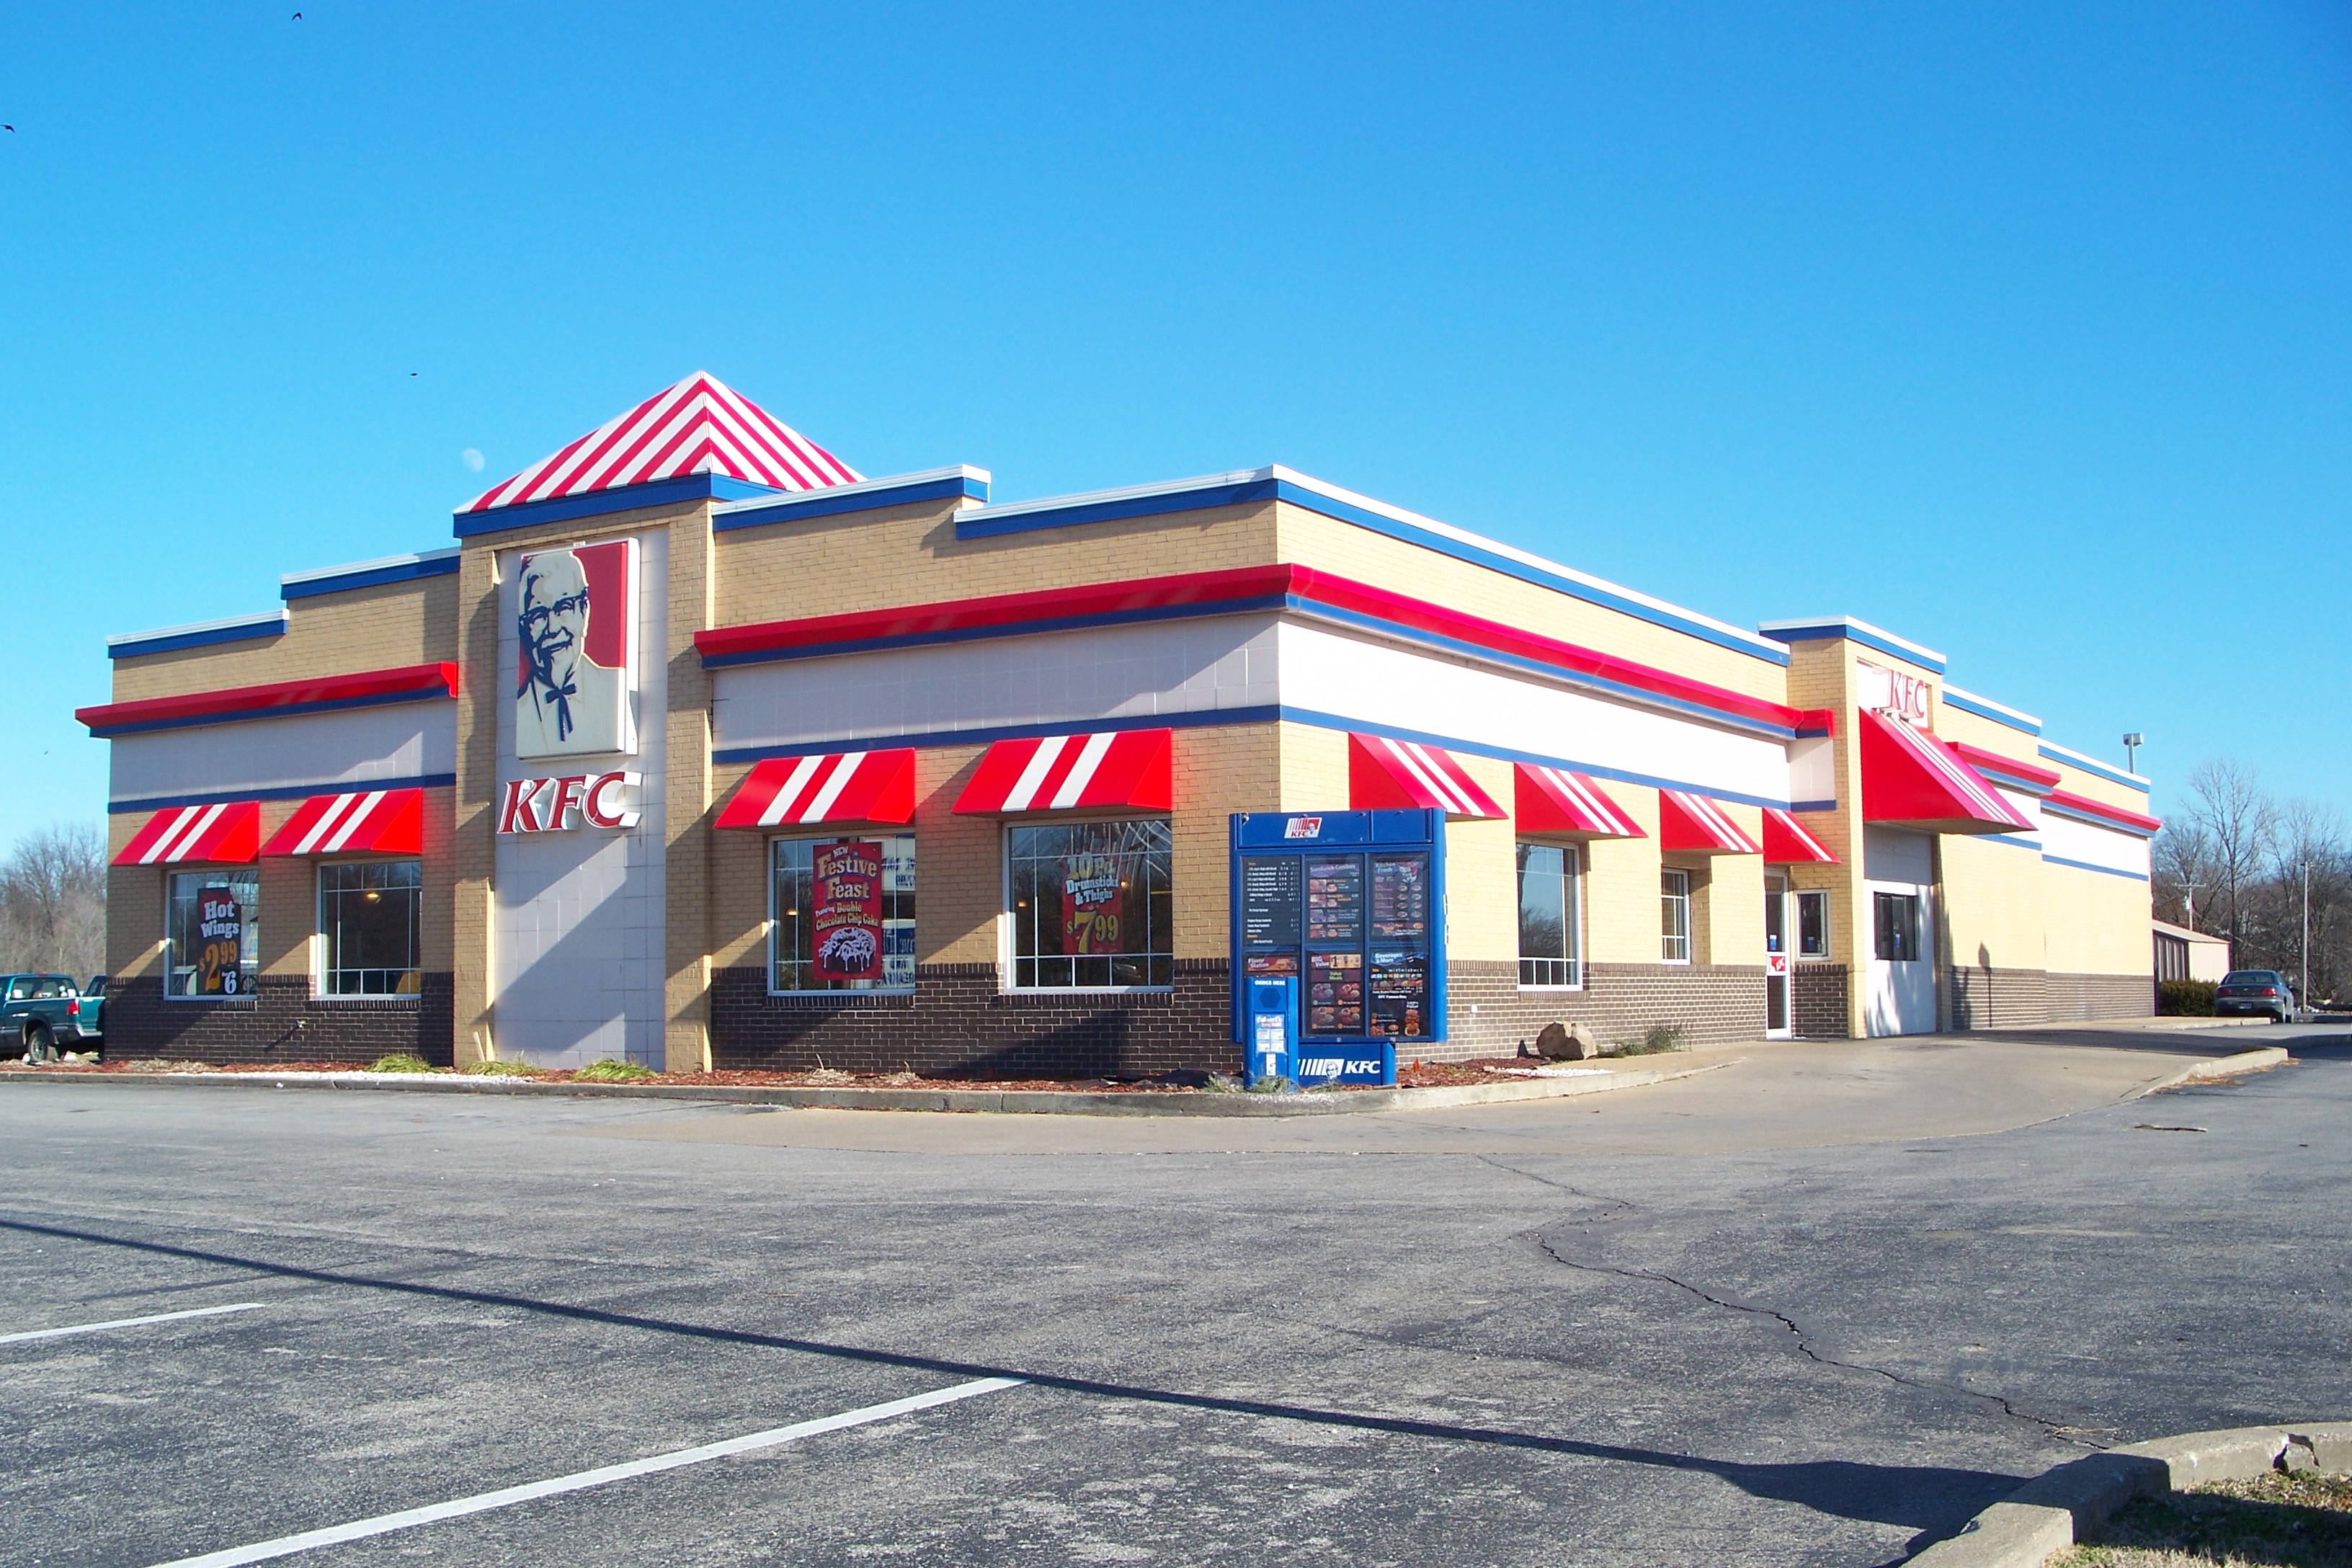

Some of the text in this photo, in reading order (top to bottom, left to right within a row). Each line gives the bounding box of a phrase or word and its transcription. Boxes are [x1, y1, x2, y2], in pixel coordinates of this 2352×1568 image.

[1888, 669, 1925, 718] KFC
[496, 771, 641, 834] KFC
[817, 851, 877, 878] Festive
[826, 876, 870, 899] Feast
[1066, 875, 1118, 894] Drumsticks
[1075, 888, 1113, 906] & Thighs
[203, 900, 236, 921] Hot
[837, 901, 862, 913] Double
[200, 921, 240, 939] Wings
[816, 912, 878, 931] Chocolate Chip Cake
[1345, 1061, 1381, 1074] KFC
